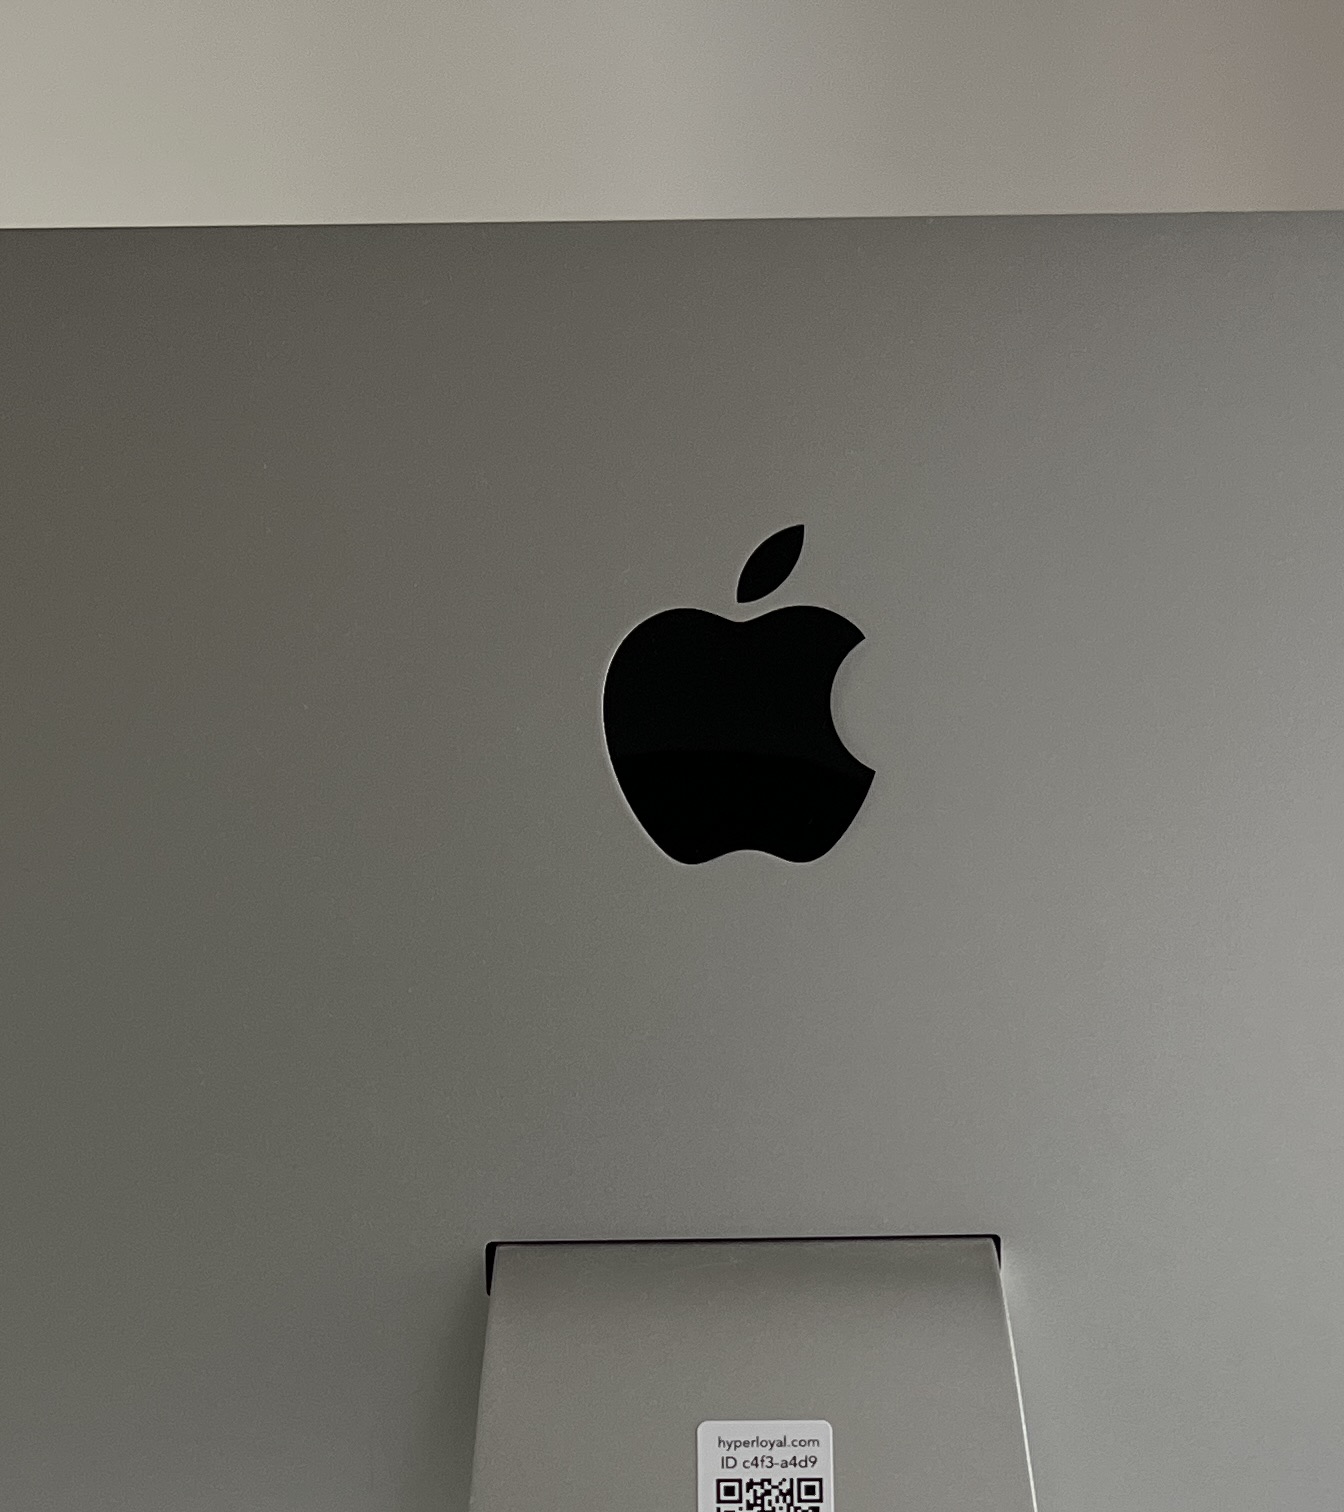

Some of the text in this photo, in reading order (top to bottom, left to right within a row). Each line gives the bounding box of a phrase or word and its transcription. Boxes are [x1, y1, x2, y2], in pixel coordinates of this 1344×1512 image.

[717, 1436, 820, 1451] hyperloyal.com
[720, 1455, 818, 1470] ID c4f3-a4d9
